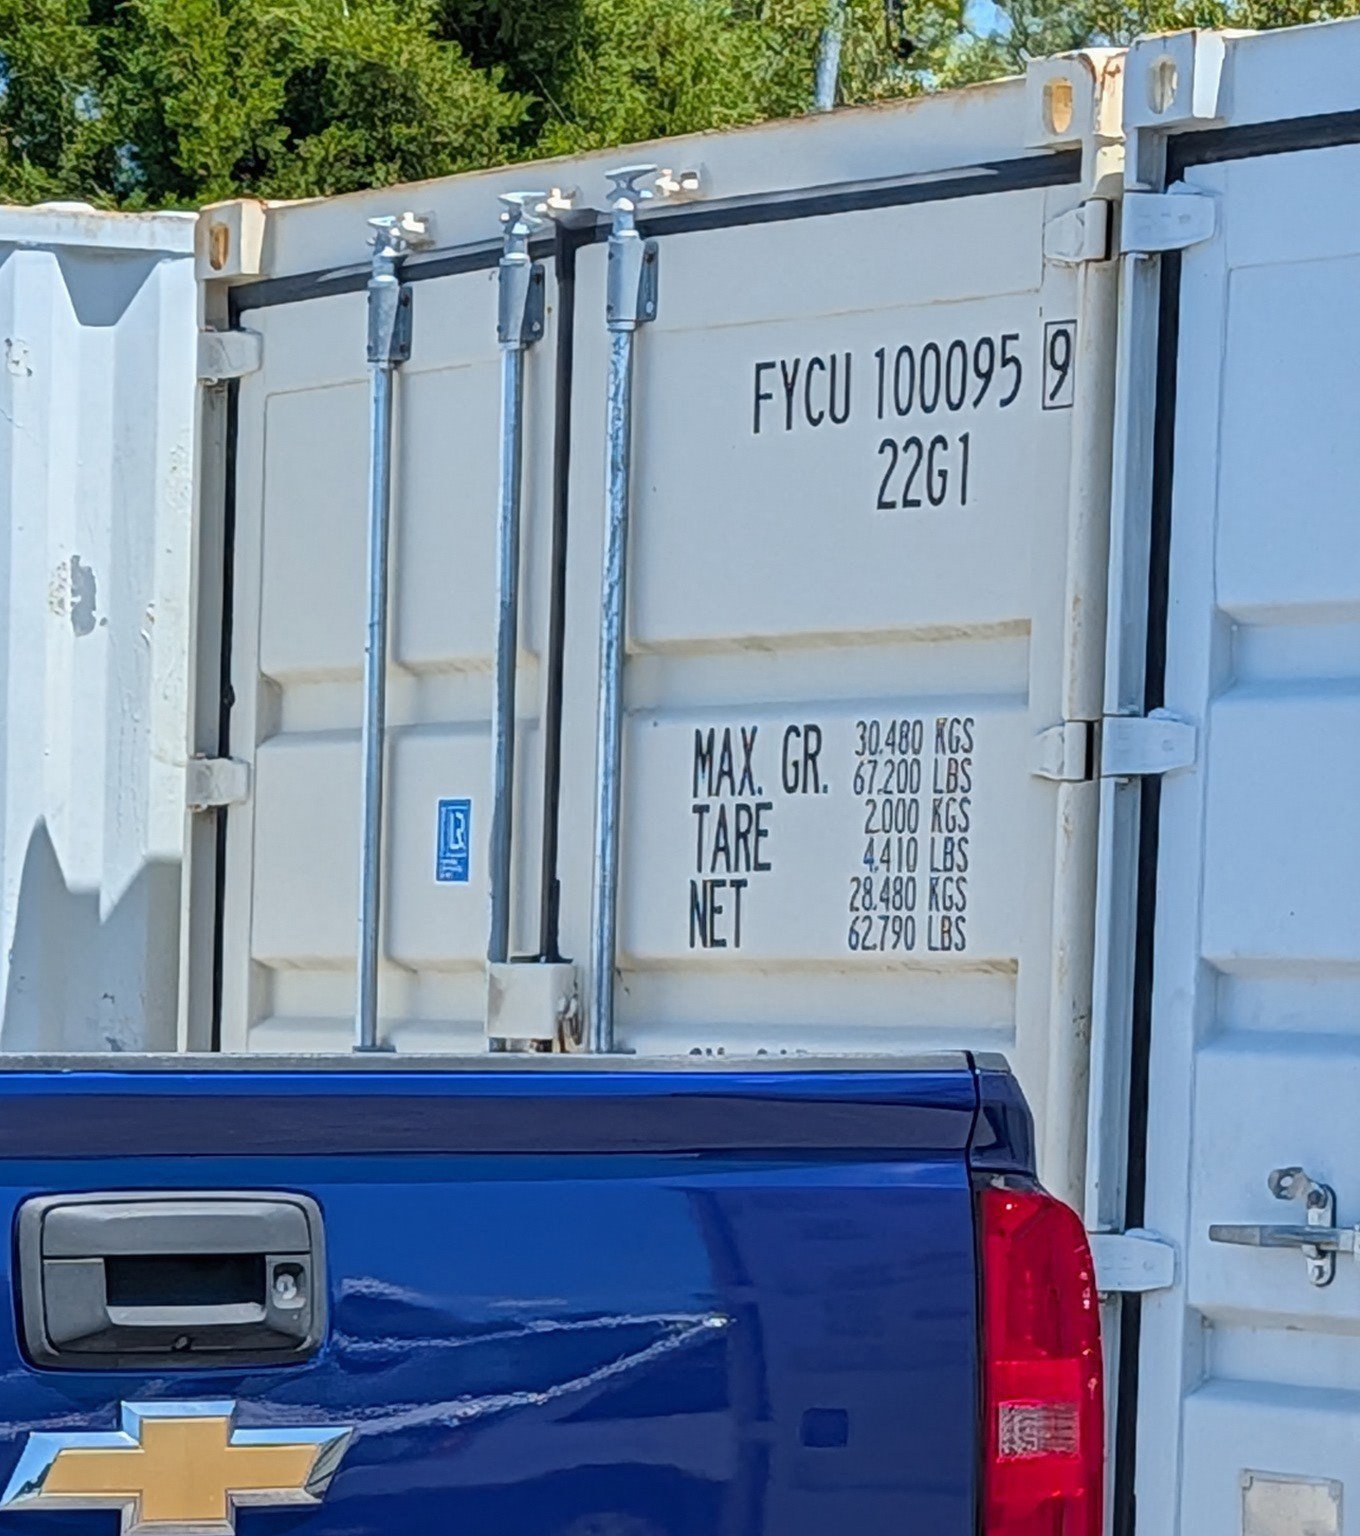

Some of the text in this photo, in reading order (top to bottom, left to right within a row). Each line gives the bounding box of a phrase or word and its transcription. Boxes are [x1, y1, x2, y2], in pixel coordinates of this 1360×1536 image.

[752, 328, 1072, 435] FYCU 100095 9
[876, 431, 971, 511] 22G1
[692, 717, 975, 798] MAX. GR. 30.480 KGS
[933, 757, 973, 795] LBS
[691, 801, 773, 874] TARE
[931, 798, 972, 834] KGS
[863, 836, 969, 874] 4.410 LBS
[688, 876, 967, 949] NET 28.480 KGS
[927, 915, 967, 952] LBS
